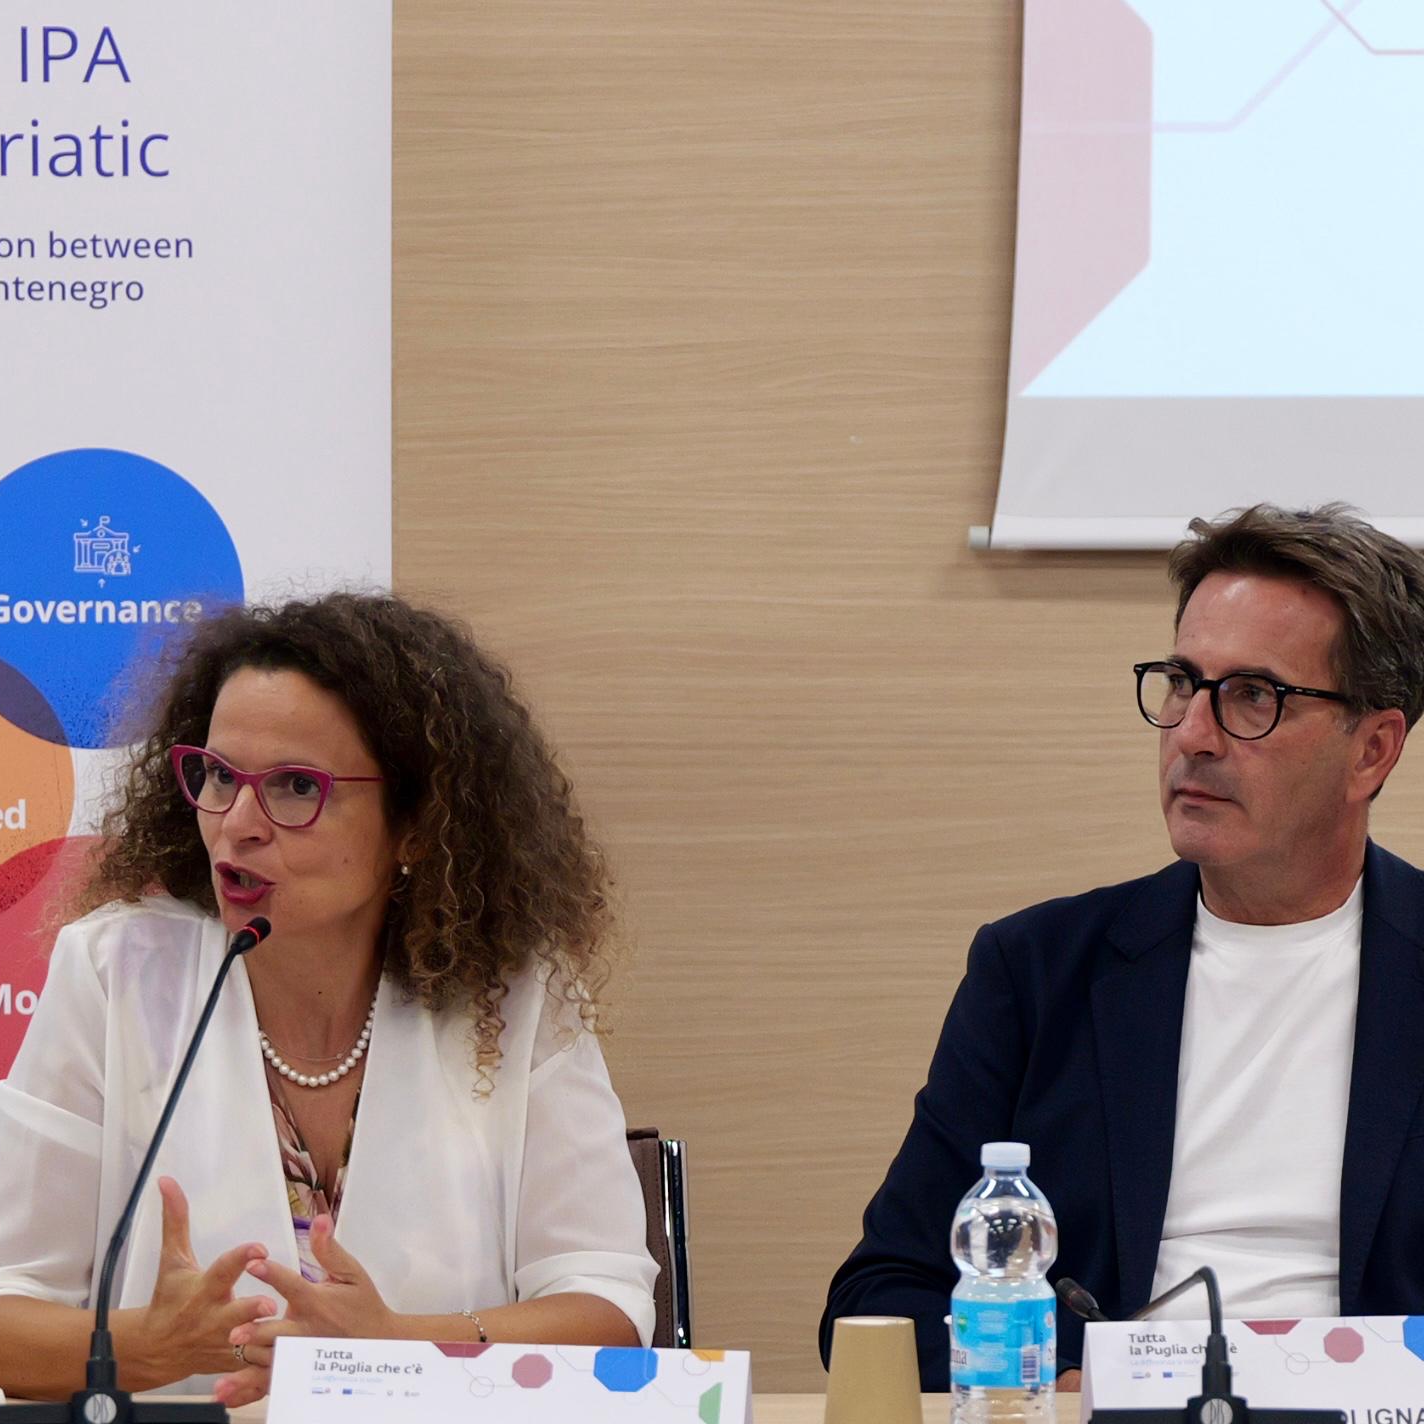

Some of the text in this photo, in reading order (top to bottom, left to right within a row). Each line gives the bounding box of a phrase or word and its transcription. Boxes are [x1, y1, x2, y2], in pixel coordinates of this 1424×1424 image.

[19, 26, 132, 83] IPA
[48, 229, 194, 260] between
[1129, 1333, 1166, 1344] Tutta
[316, 1348, 353, 1360] Tutta
[1129, 1344, 1208, 1358] la Puglia ch
[313, 1360, 326, 1372] la
[330, 1361, 373, 1375] Puglia
[376, 1363, 401, 1374] che
